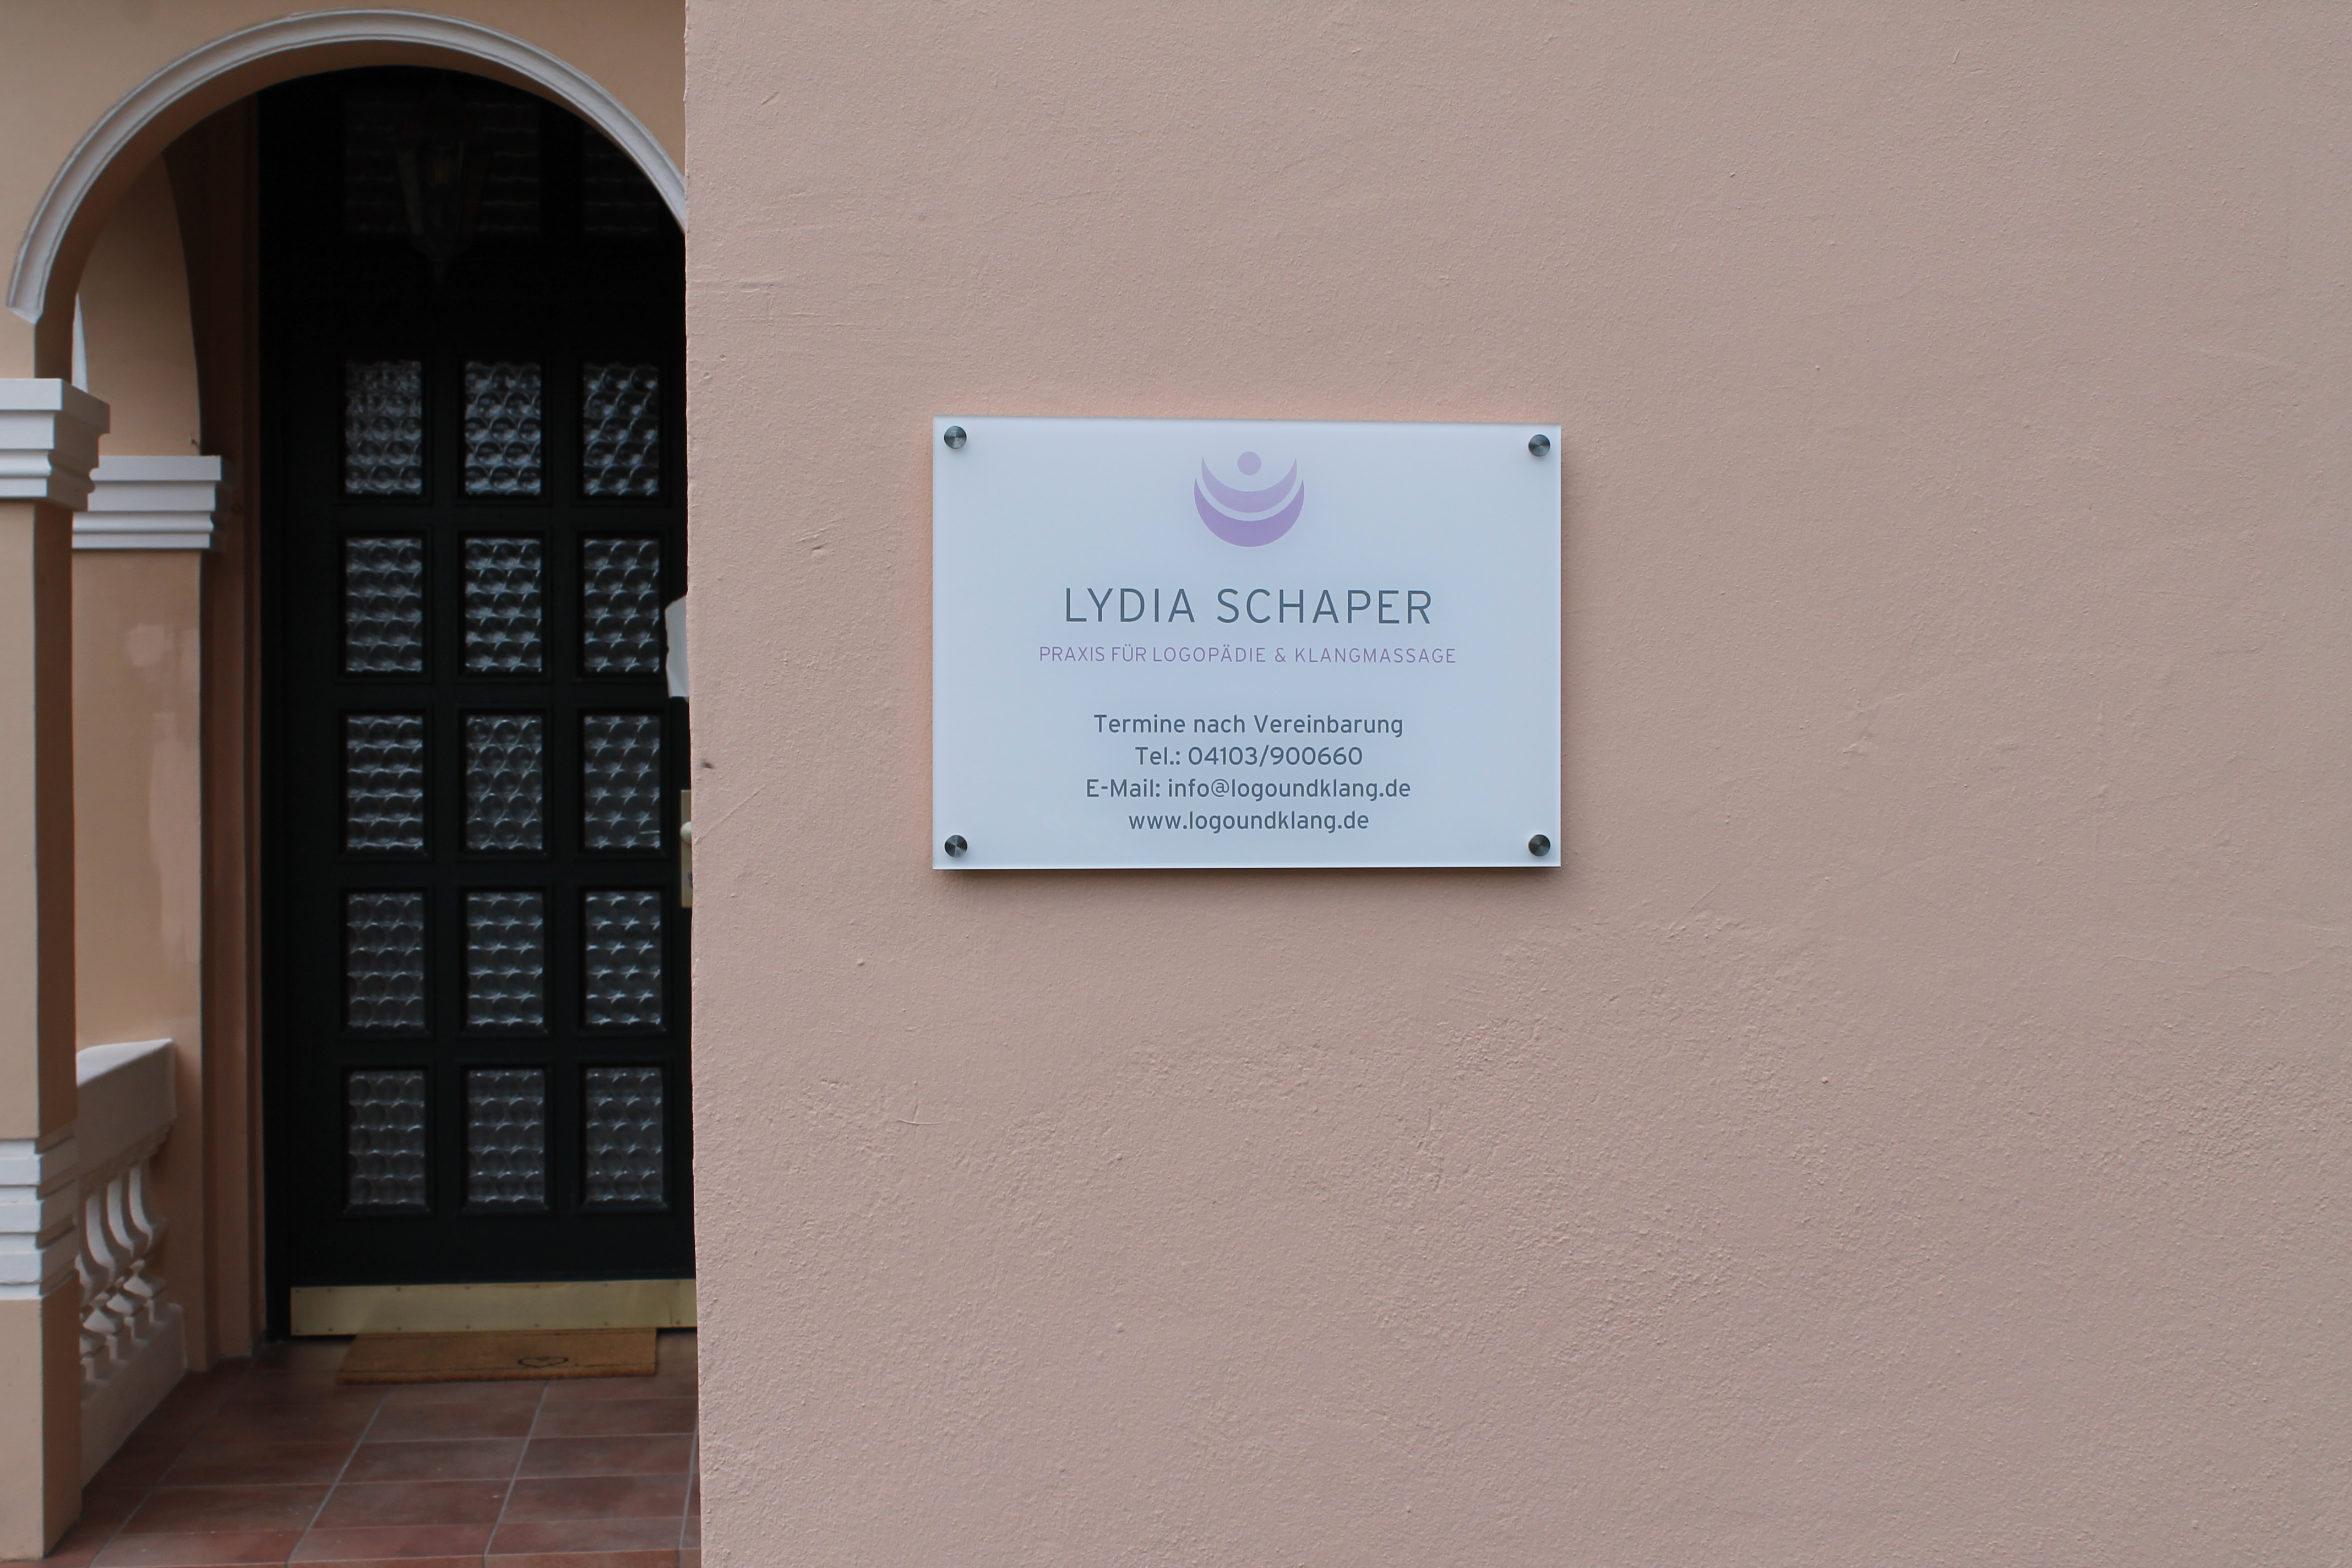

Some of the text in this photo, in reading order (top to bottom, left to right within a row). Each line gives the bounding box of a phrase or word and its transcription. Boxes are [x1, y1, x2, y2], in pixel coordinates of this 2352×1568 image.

[1065, 587, 1433, 625] LYDIA SCHAPER
[1039, 644, 1456, 664] PRAXIS FÜR LOGOPÄDIE & KLANGMASSAGE
[1093, 714, 1403, 738] Termine nach Vereinbarung
[1135, 744, 1363, 767] Tel.: 04103/900660
[1087, 778, 1412, 802] E-Mail: info@logoundklang.de
[1128, 810, 1369, 834] www.logoundklang.de
